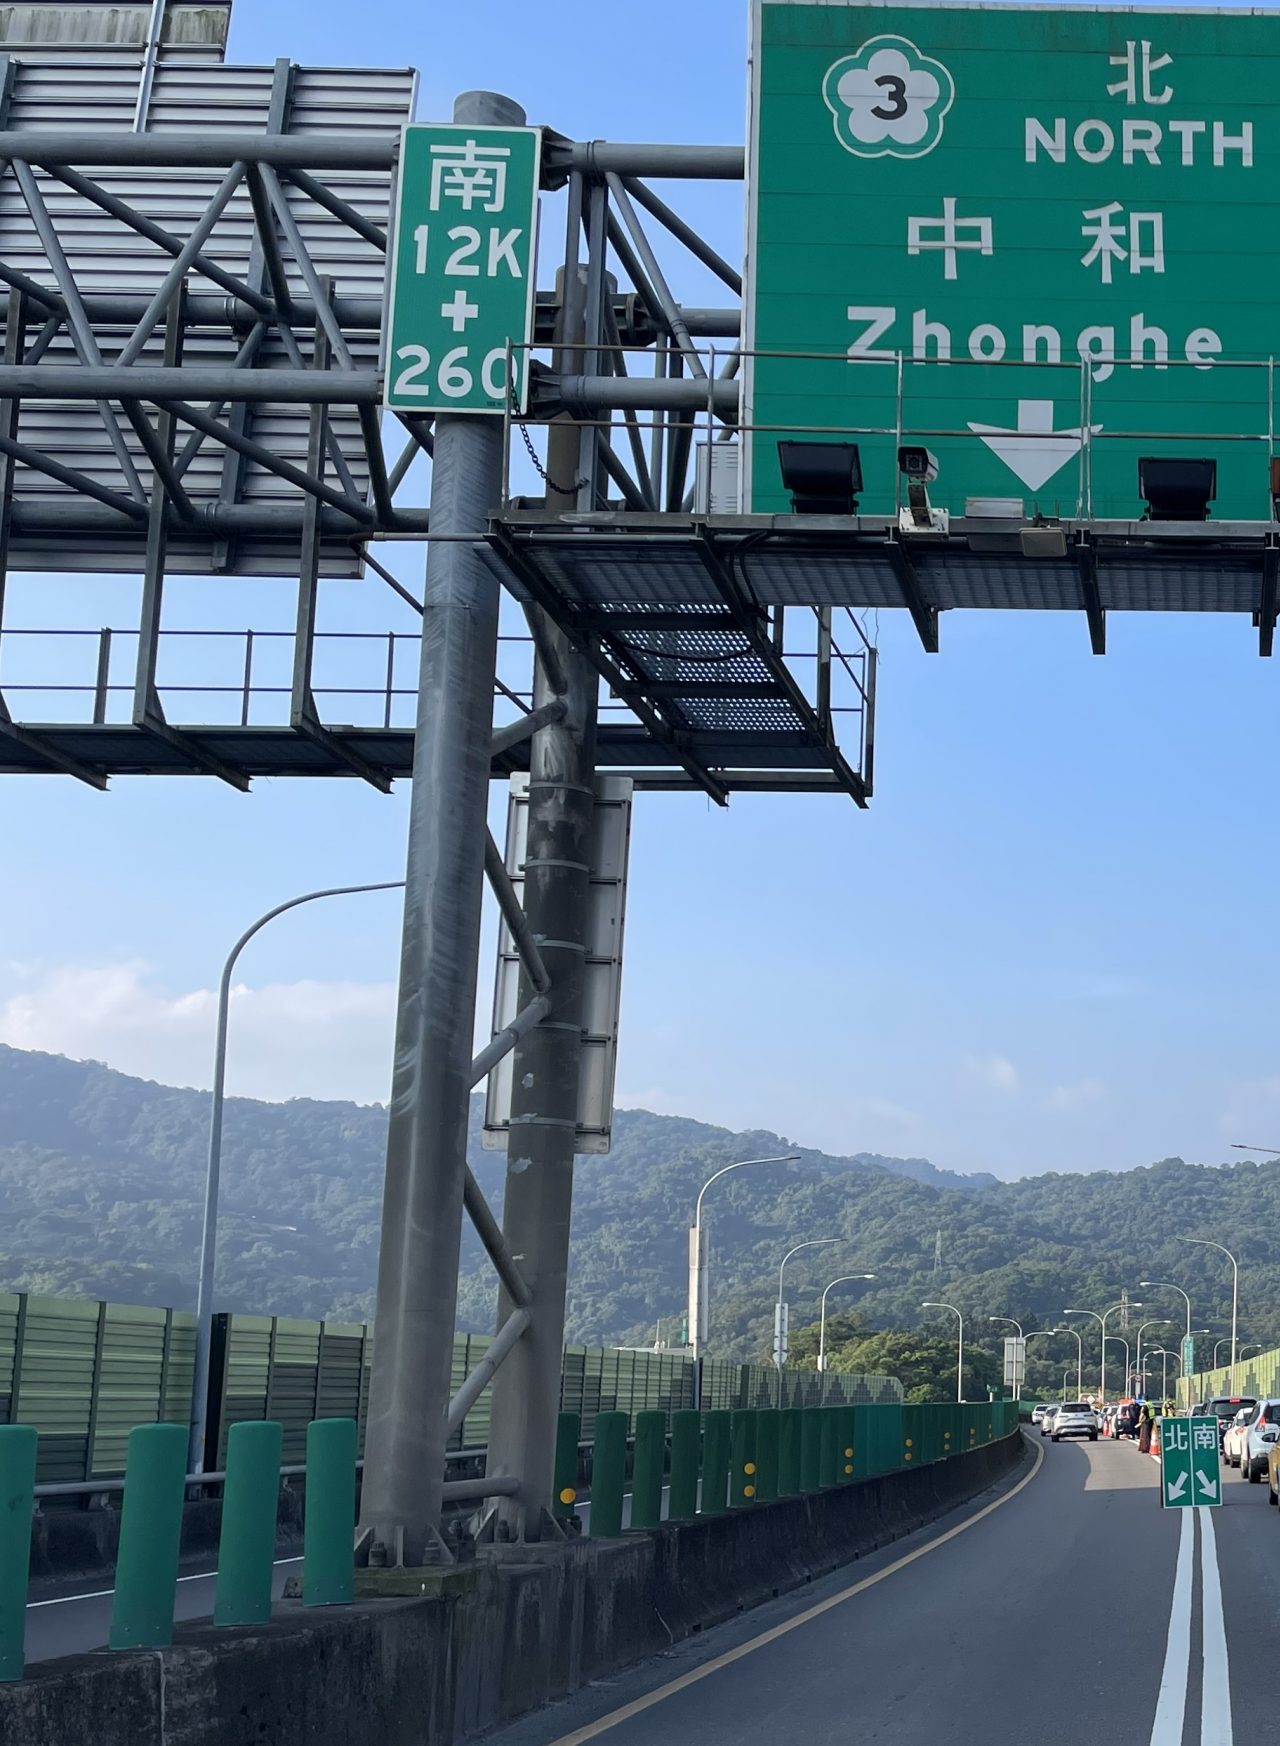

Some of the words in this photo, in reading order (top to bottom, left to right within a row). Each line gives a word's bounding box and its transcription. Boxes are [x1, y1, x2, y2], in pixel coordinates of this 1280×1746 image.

[870, 75, 907, 120] 3
[1107, 40, 1174, 105] 北
[1025, 117, 1254, 167] NORTH
[429, 139, 511, 213] 南
[413, 224, 523, 278] 12K
[907, 197, 1166, 284] 中和
[393, 344, 518, 400] 260
[846, 306, 1223, 383] Zhonghe
[1165, 1424, 1188, 1451] 北
[1193, 1423, 1216, 1450] 南
